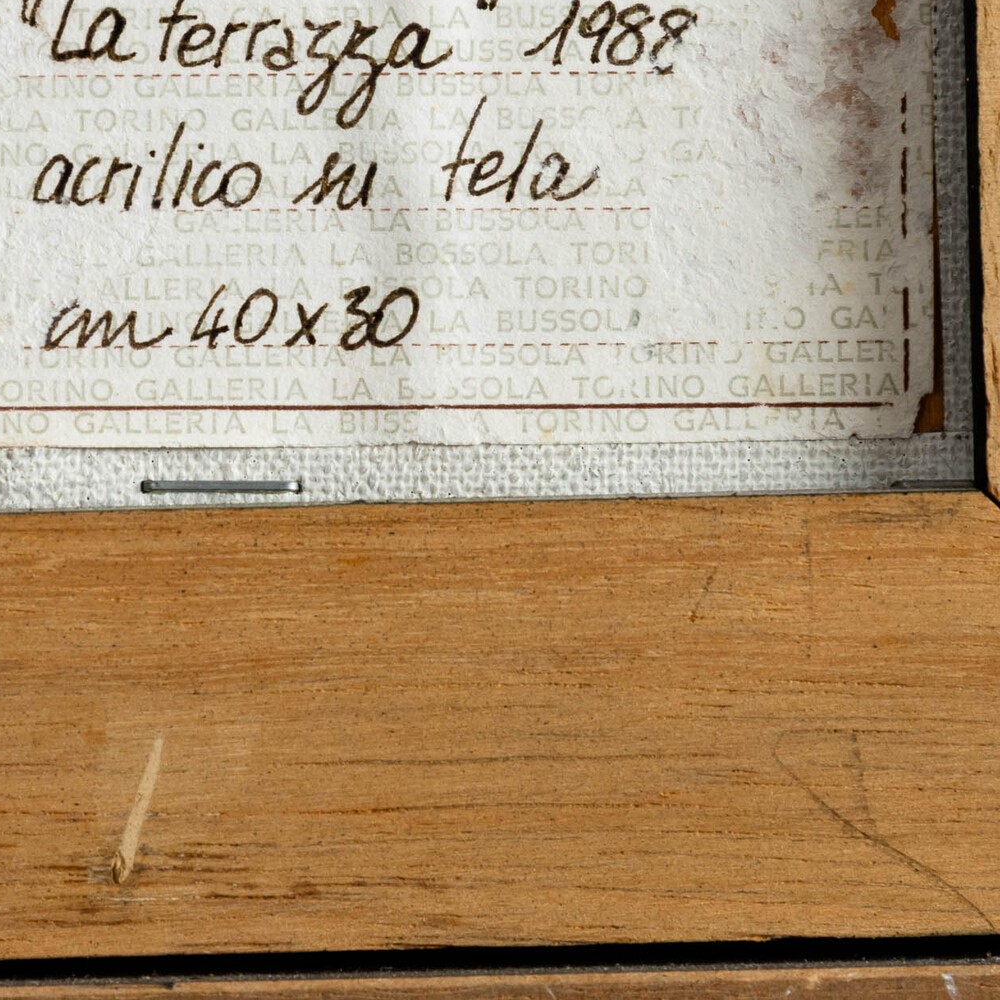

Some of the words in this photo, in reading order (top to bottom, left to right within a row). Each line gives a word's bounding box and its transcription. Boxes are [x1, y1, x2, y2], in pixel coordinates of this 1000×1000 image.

[428, 5, 471, 29] LA
[134, 73, 305, 99] GALLERIA
[396, 71, 546, 97] BUSSOLA
[74, 108, 207, 133] TORINO
[32, 120, 263, 212] acrilico
[292, 151, 378, 211] su
[440, 96, 600, 203] tela
[270, 140, 313, 166] LA
[368, 207, 412, 232] LA
[330, 241, 373, 267] LA
[570, 239, 650, 266] TORI
[513, 273, 648, 299] TORINO
[429, 308, 471, 334] LA
[173, 342, 346, 369] GALLERIA
[368, 341, 413, 367] LA
[135, 376, 308, 403] GALLERIA
[331, 376, 374, 402] LA
[728, 372, 901, 399] GALLERIA
[73, 410, 247, 436] GALLERIA
[271, 410, 315, 435] LA
[515, 408, 649, 434] TORINO
